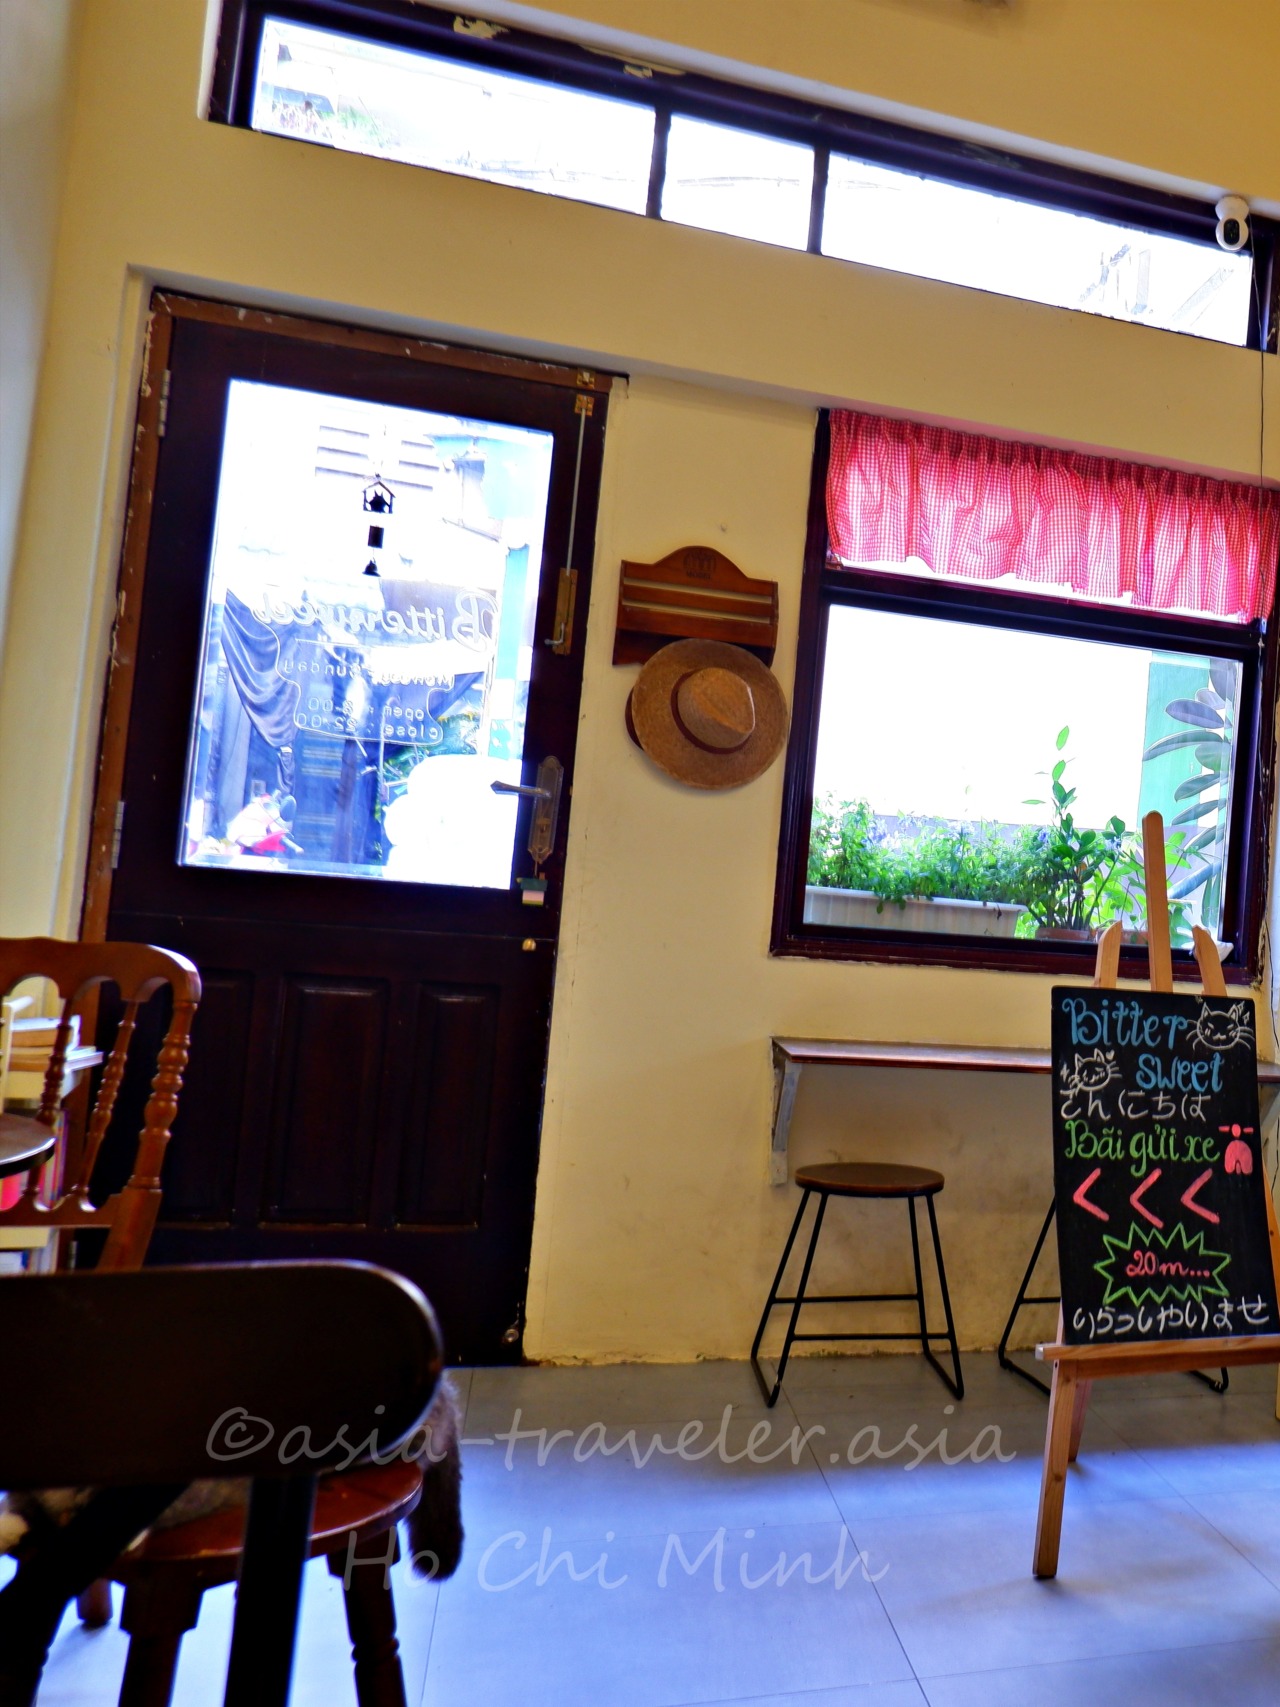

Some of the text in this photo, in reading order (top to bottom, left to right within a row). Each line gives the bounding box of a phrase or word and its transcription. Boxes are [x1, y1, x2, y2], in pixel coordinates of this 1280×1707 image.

[1062, 998, 1188, 1049] Bitter
[1060, 1089, 1211, 1122] こんにちは
[1064, 1120, 1125, 1161] Bãi
[1181, 1135, 1220, 1162] xe
